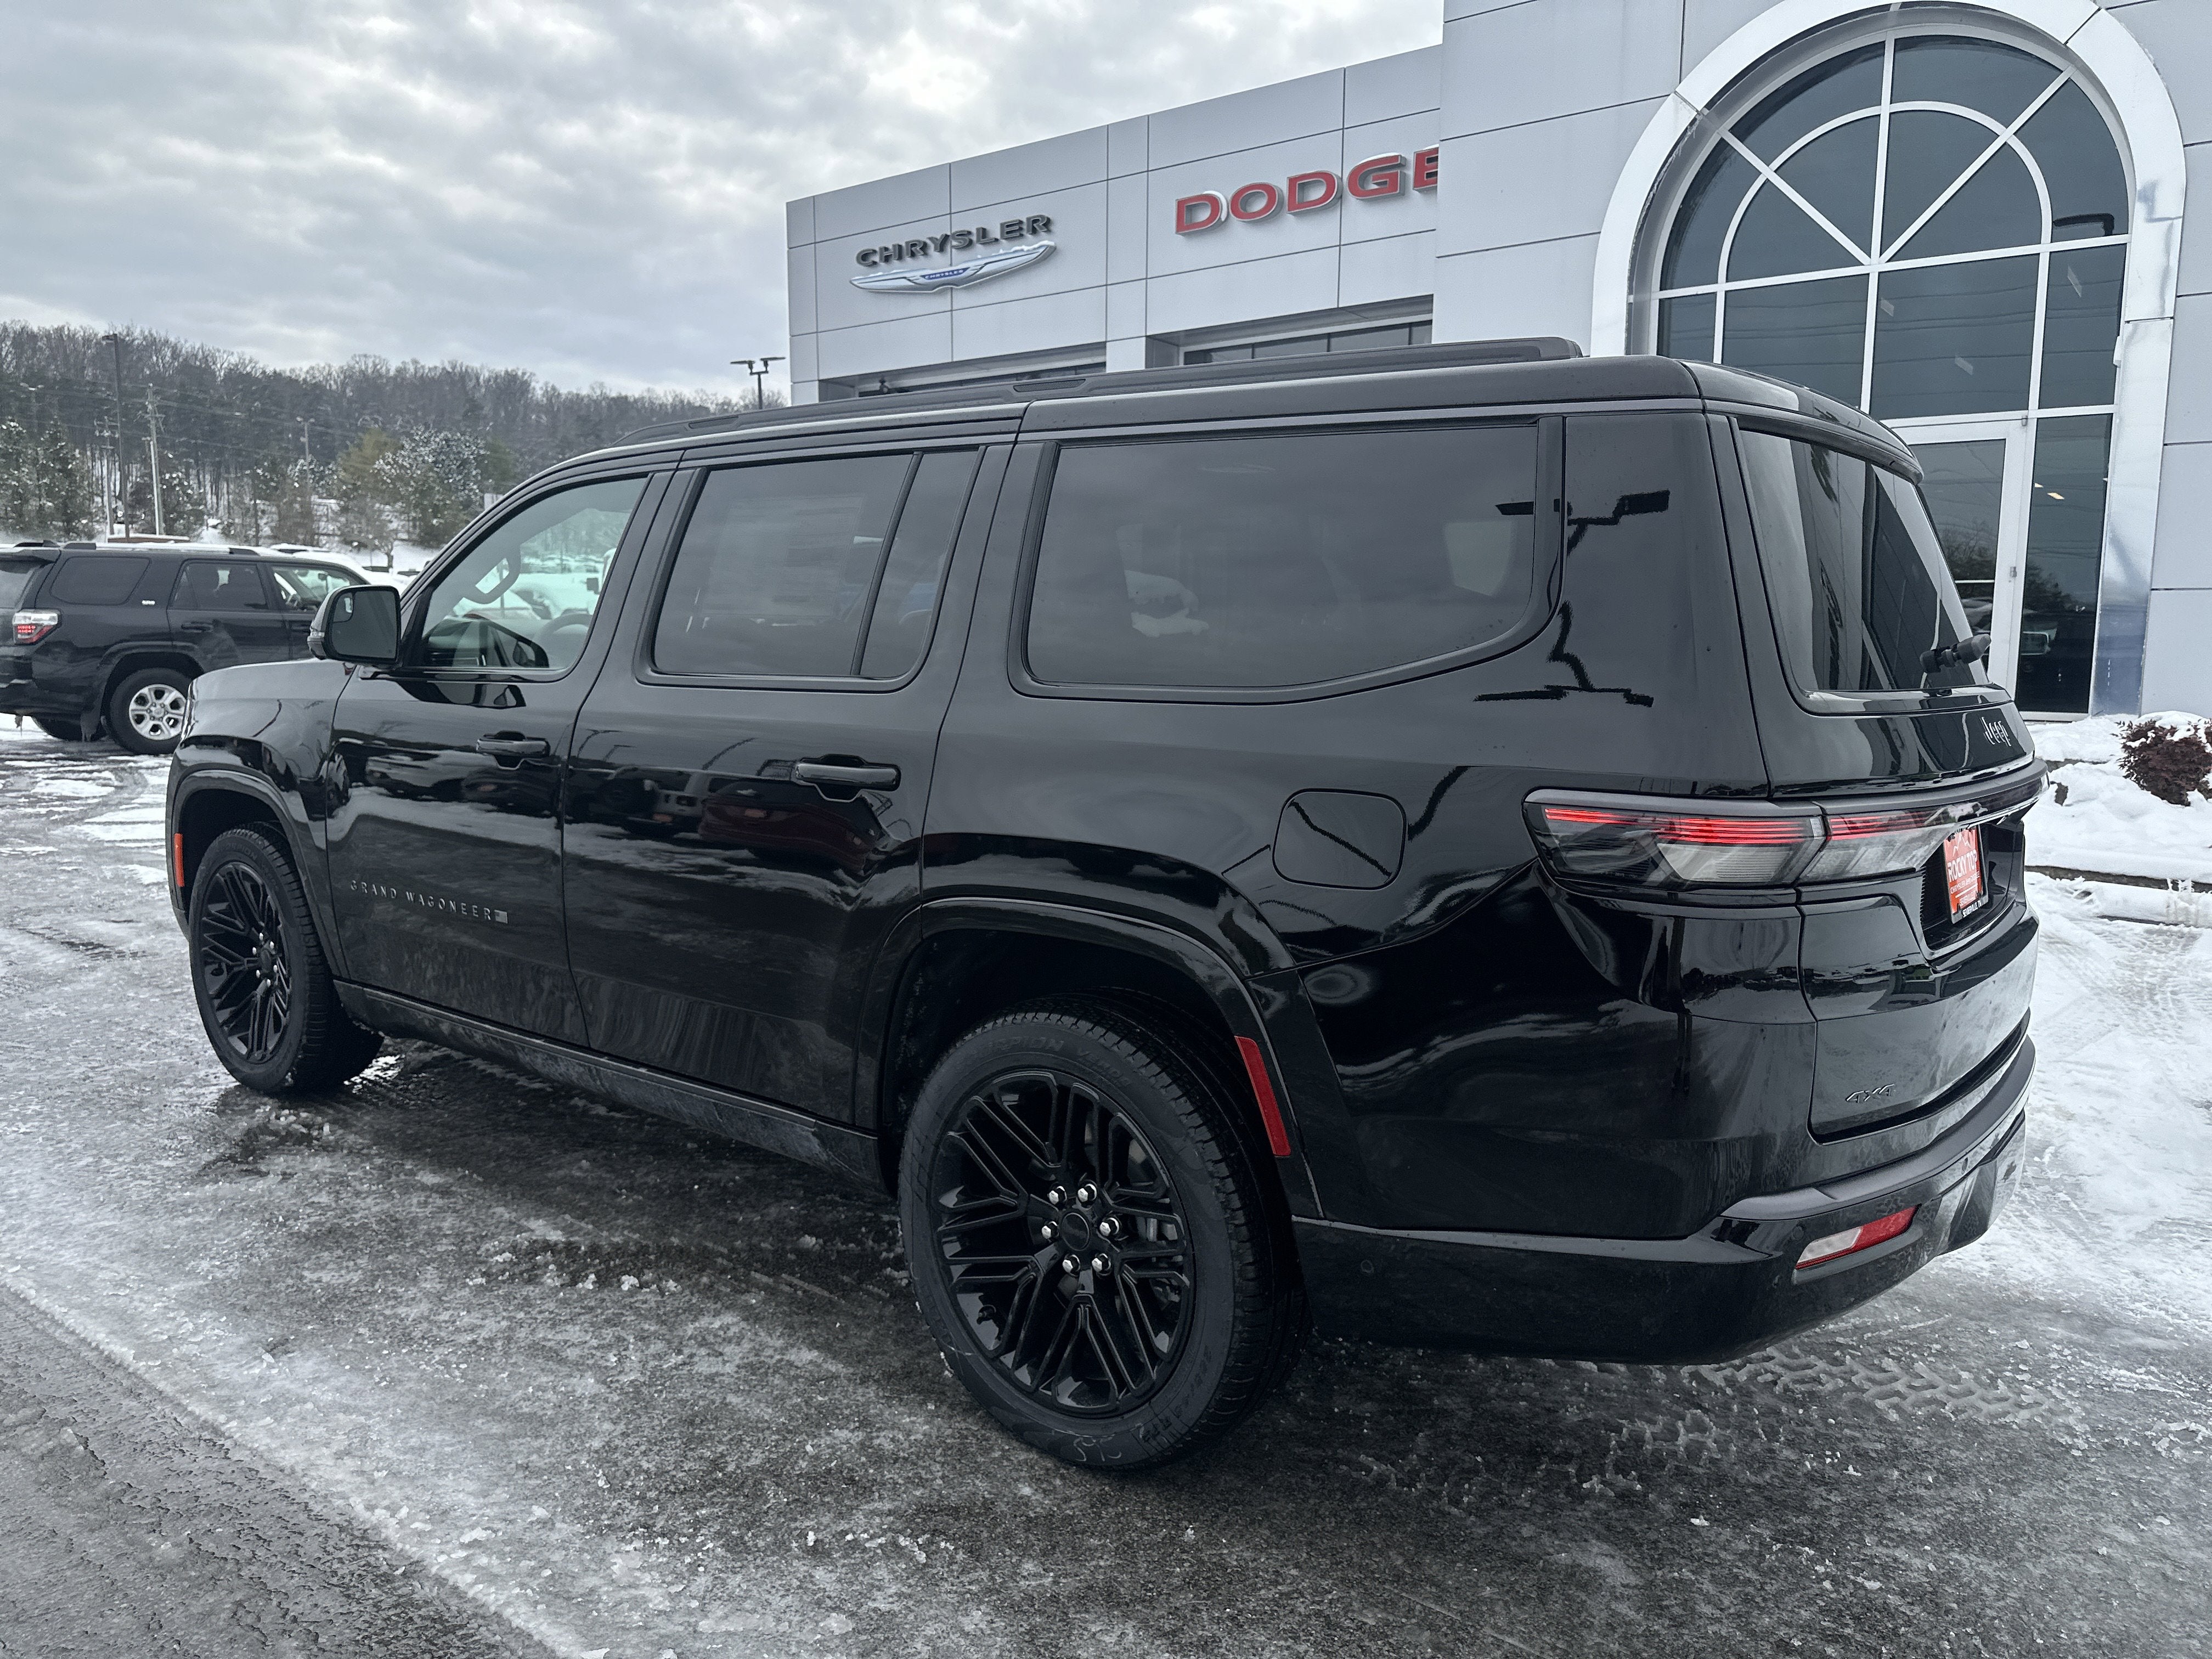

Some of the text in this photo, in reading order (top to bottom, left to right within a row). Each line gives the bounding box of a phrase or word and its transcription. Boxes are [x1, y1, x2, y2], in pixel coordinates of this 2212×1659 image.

[1175, 145, 1439, 236] DODGE
[856, 214, 1052, 267] CHRYSLER
[1980, 716, 2012, 747] Jeep
[1948, 855, 1967, 882] ROCKY
[351, 880, 492, 921] GRAND WAGONEER
